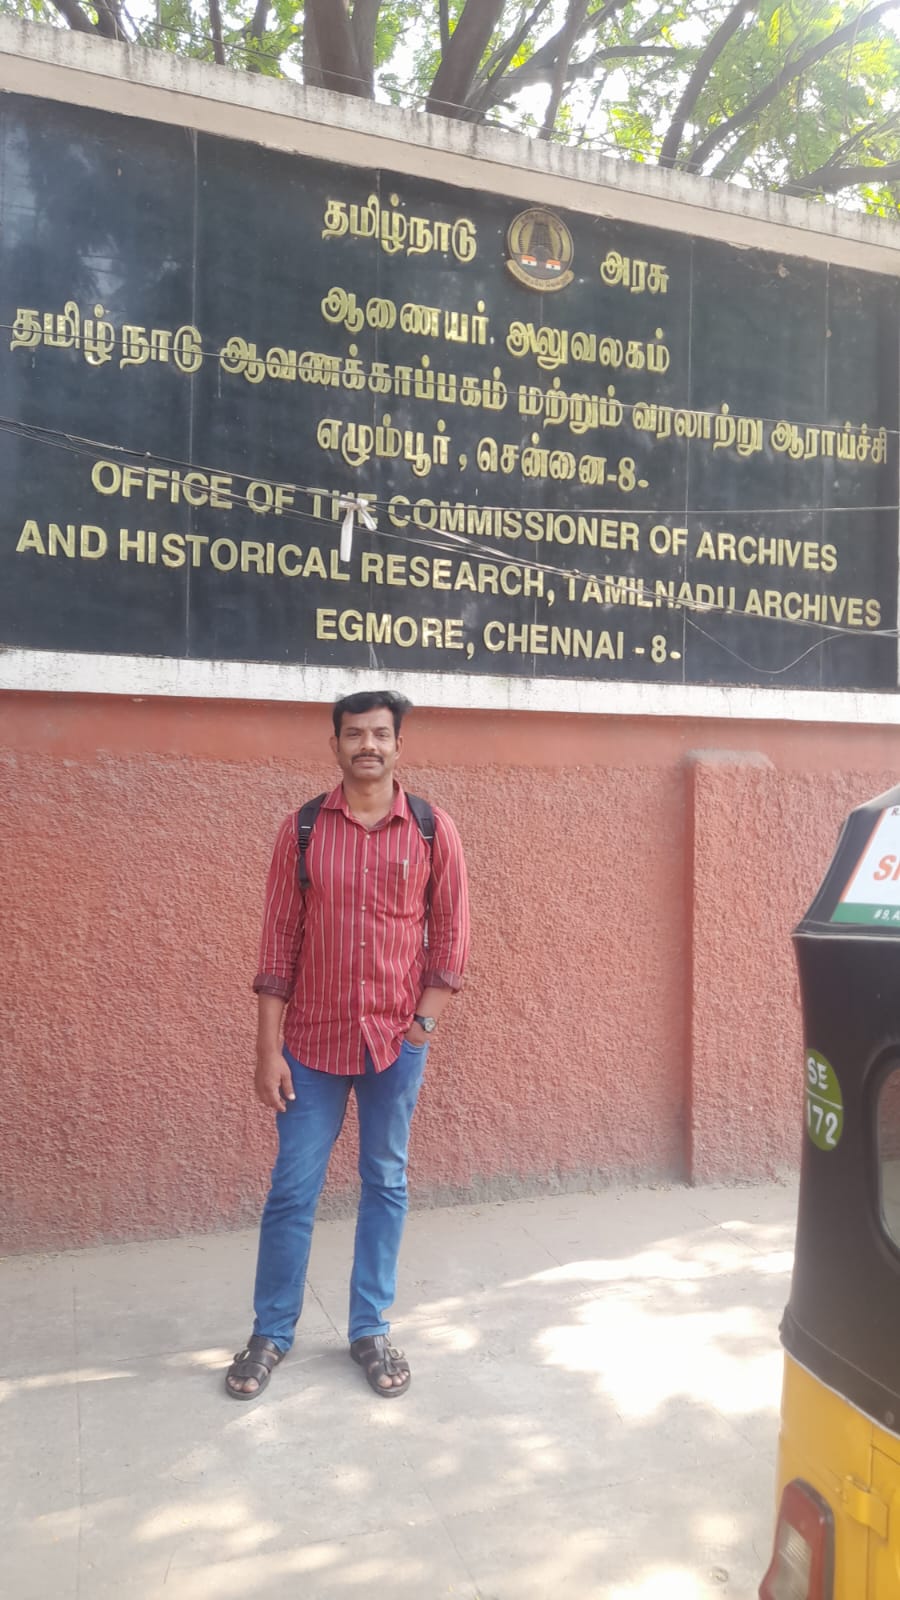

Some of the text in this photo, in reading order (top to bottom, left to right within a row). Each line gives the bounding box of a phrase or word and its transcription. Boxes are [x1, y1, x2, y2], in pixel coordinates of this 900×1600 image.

[322, 193, 477, 262] தமிழ்நாடு
[600, 251, 669, 293] அரசு
[321, 287, 670, 373] ஆணையர் அலுவலகம்
[10, 301, 888, 464] தமிழ்நாடு ஆவணக்காப்பகம் மற்றும் வரலாற்று ஆராய்ச்சி
[91, 460, 838, 573] OFFICE OF THE COMMISSIONER OF ARCHIVES
[16, 519, 882, 627] AND HISTORICAL RESEARCH, TAMILNADU ARCHIVES
[316, 608, 475, 660] EGMORE,
[483, 621, 624, 660] CHENNAI
[807, 1057, 828, 1090] SE
